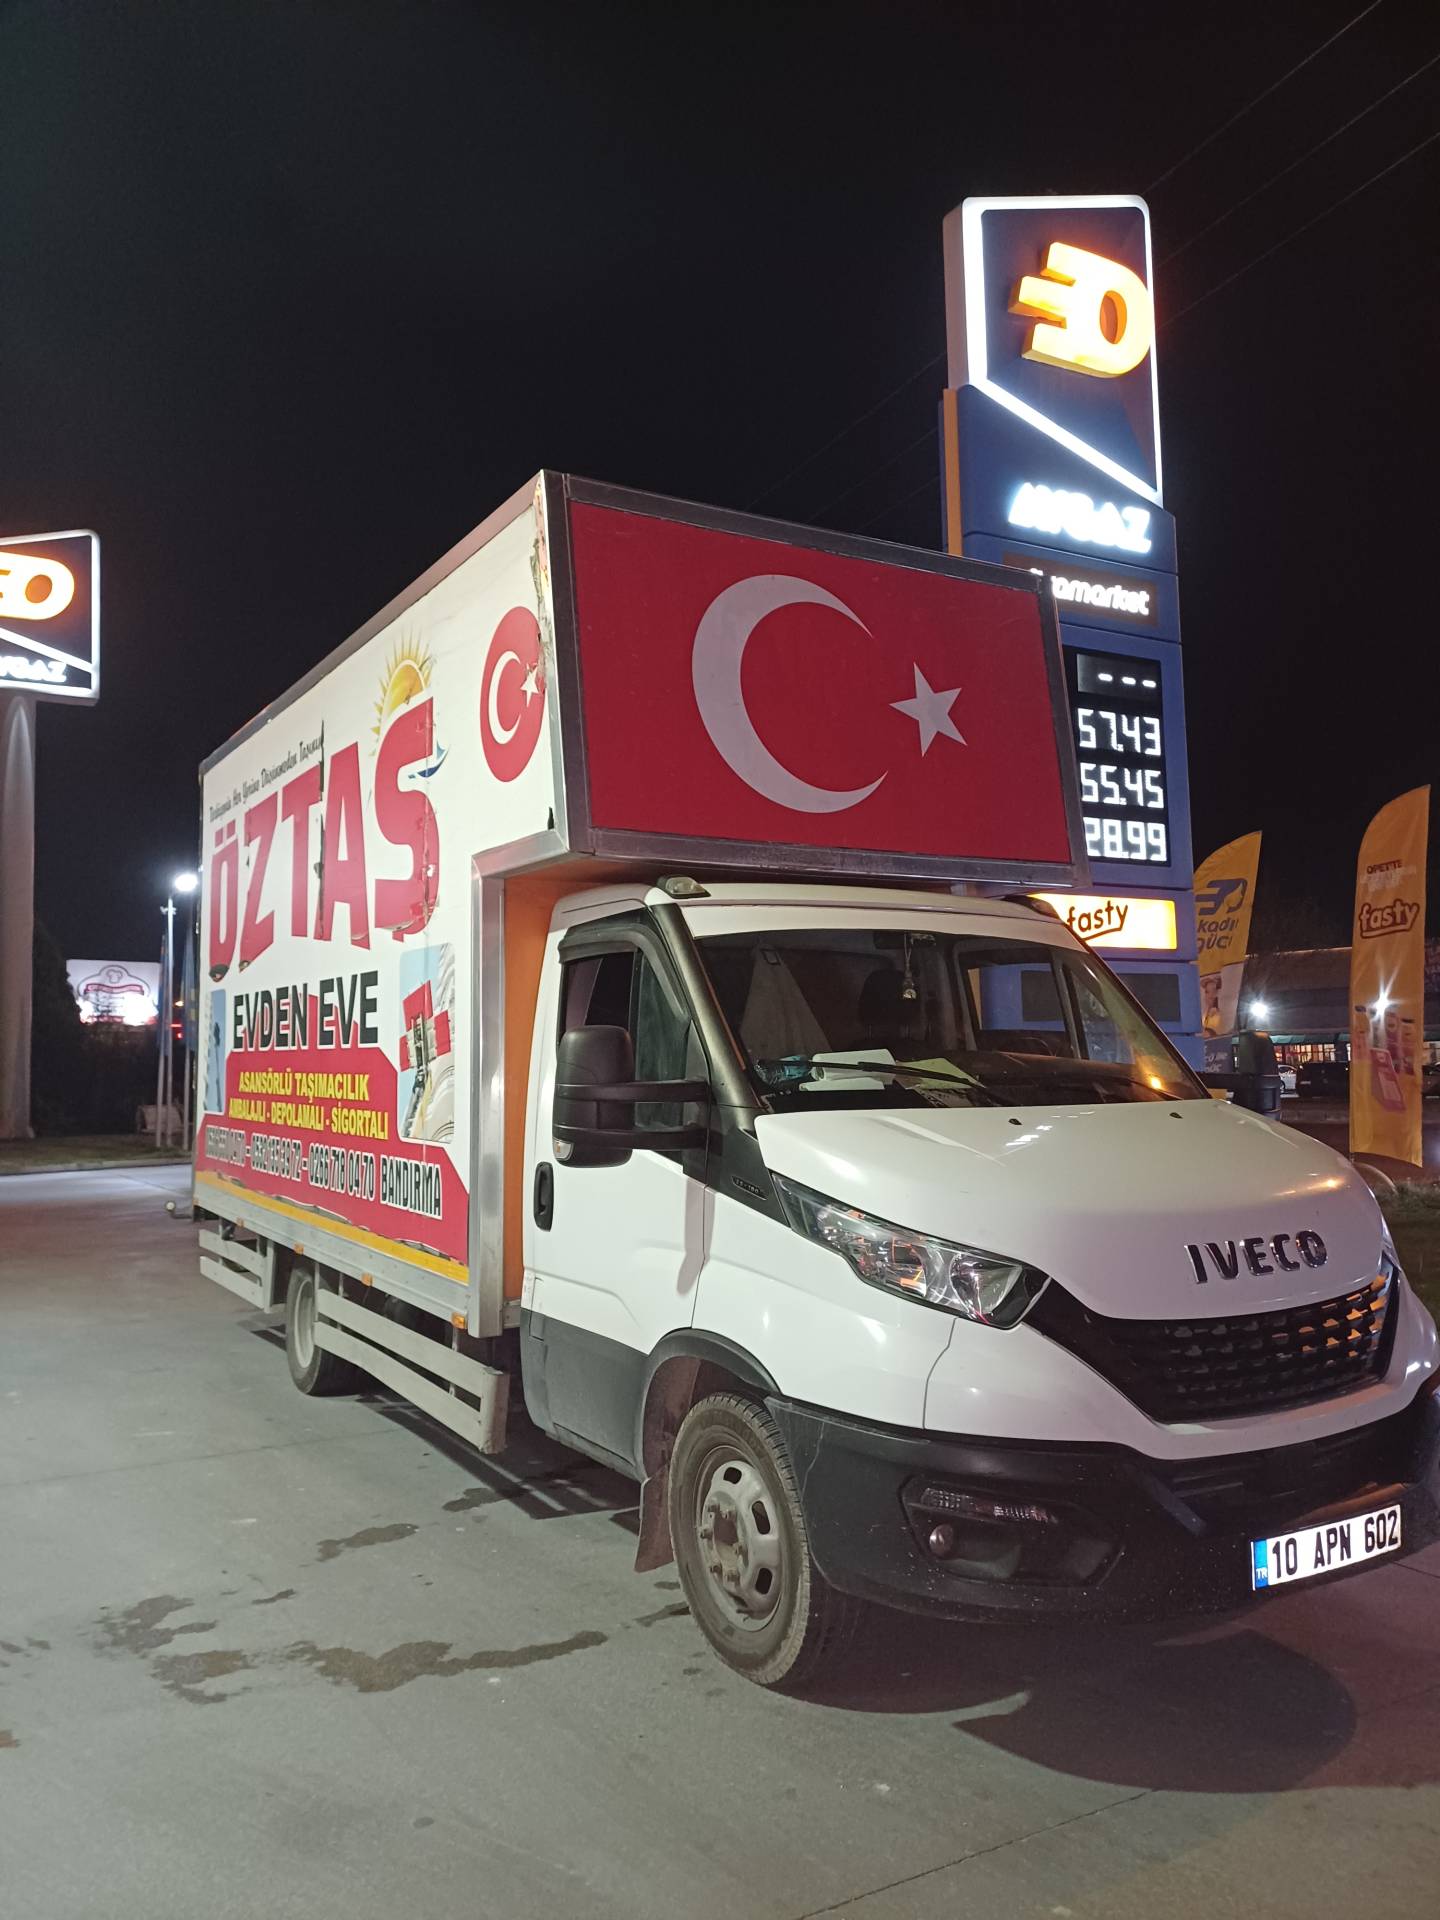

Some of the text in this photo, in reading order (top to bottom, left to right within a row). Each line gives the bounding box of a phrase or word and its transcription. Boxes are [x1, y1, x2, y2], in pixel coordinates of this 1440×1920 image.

[1077, 708, 1161, 756] 57.43
[1080, 763, 1164, 809] 55.45
[1083, 817, 1167, 861] 28.99
[1066, 900, 1128, 934] fasty
[1359, 899, 1420, 935] fasty
[233, 970, 379, 1050] EVDEN EVE
[238, 1067, 370, 1103] ASANSÖRLÜ TAŞIMACILIK
[271, 1101, 324, 1131] DEPOLAMALI
[331, 1102, 389, 1141] SİGORTALI
[309, 1143, 330, 1189] 0266
[381, 1155, 442, 1219] BANDIRMA
[1184, 1230, 1329, 1285] IVECO
[1256, 1509, 1398, 1579] TR 10 APN 602
